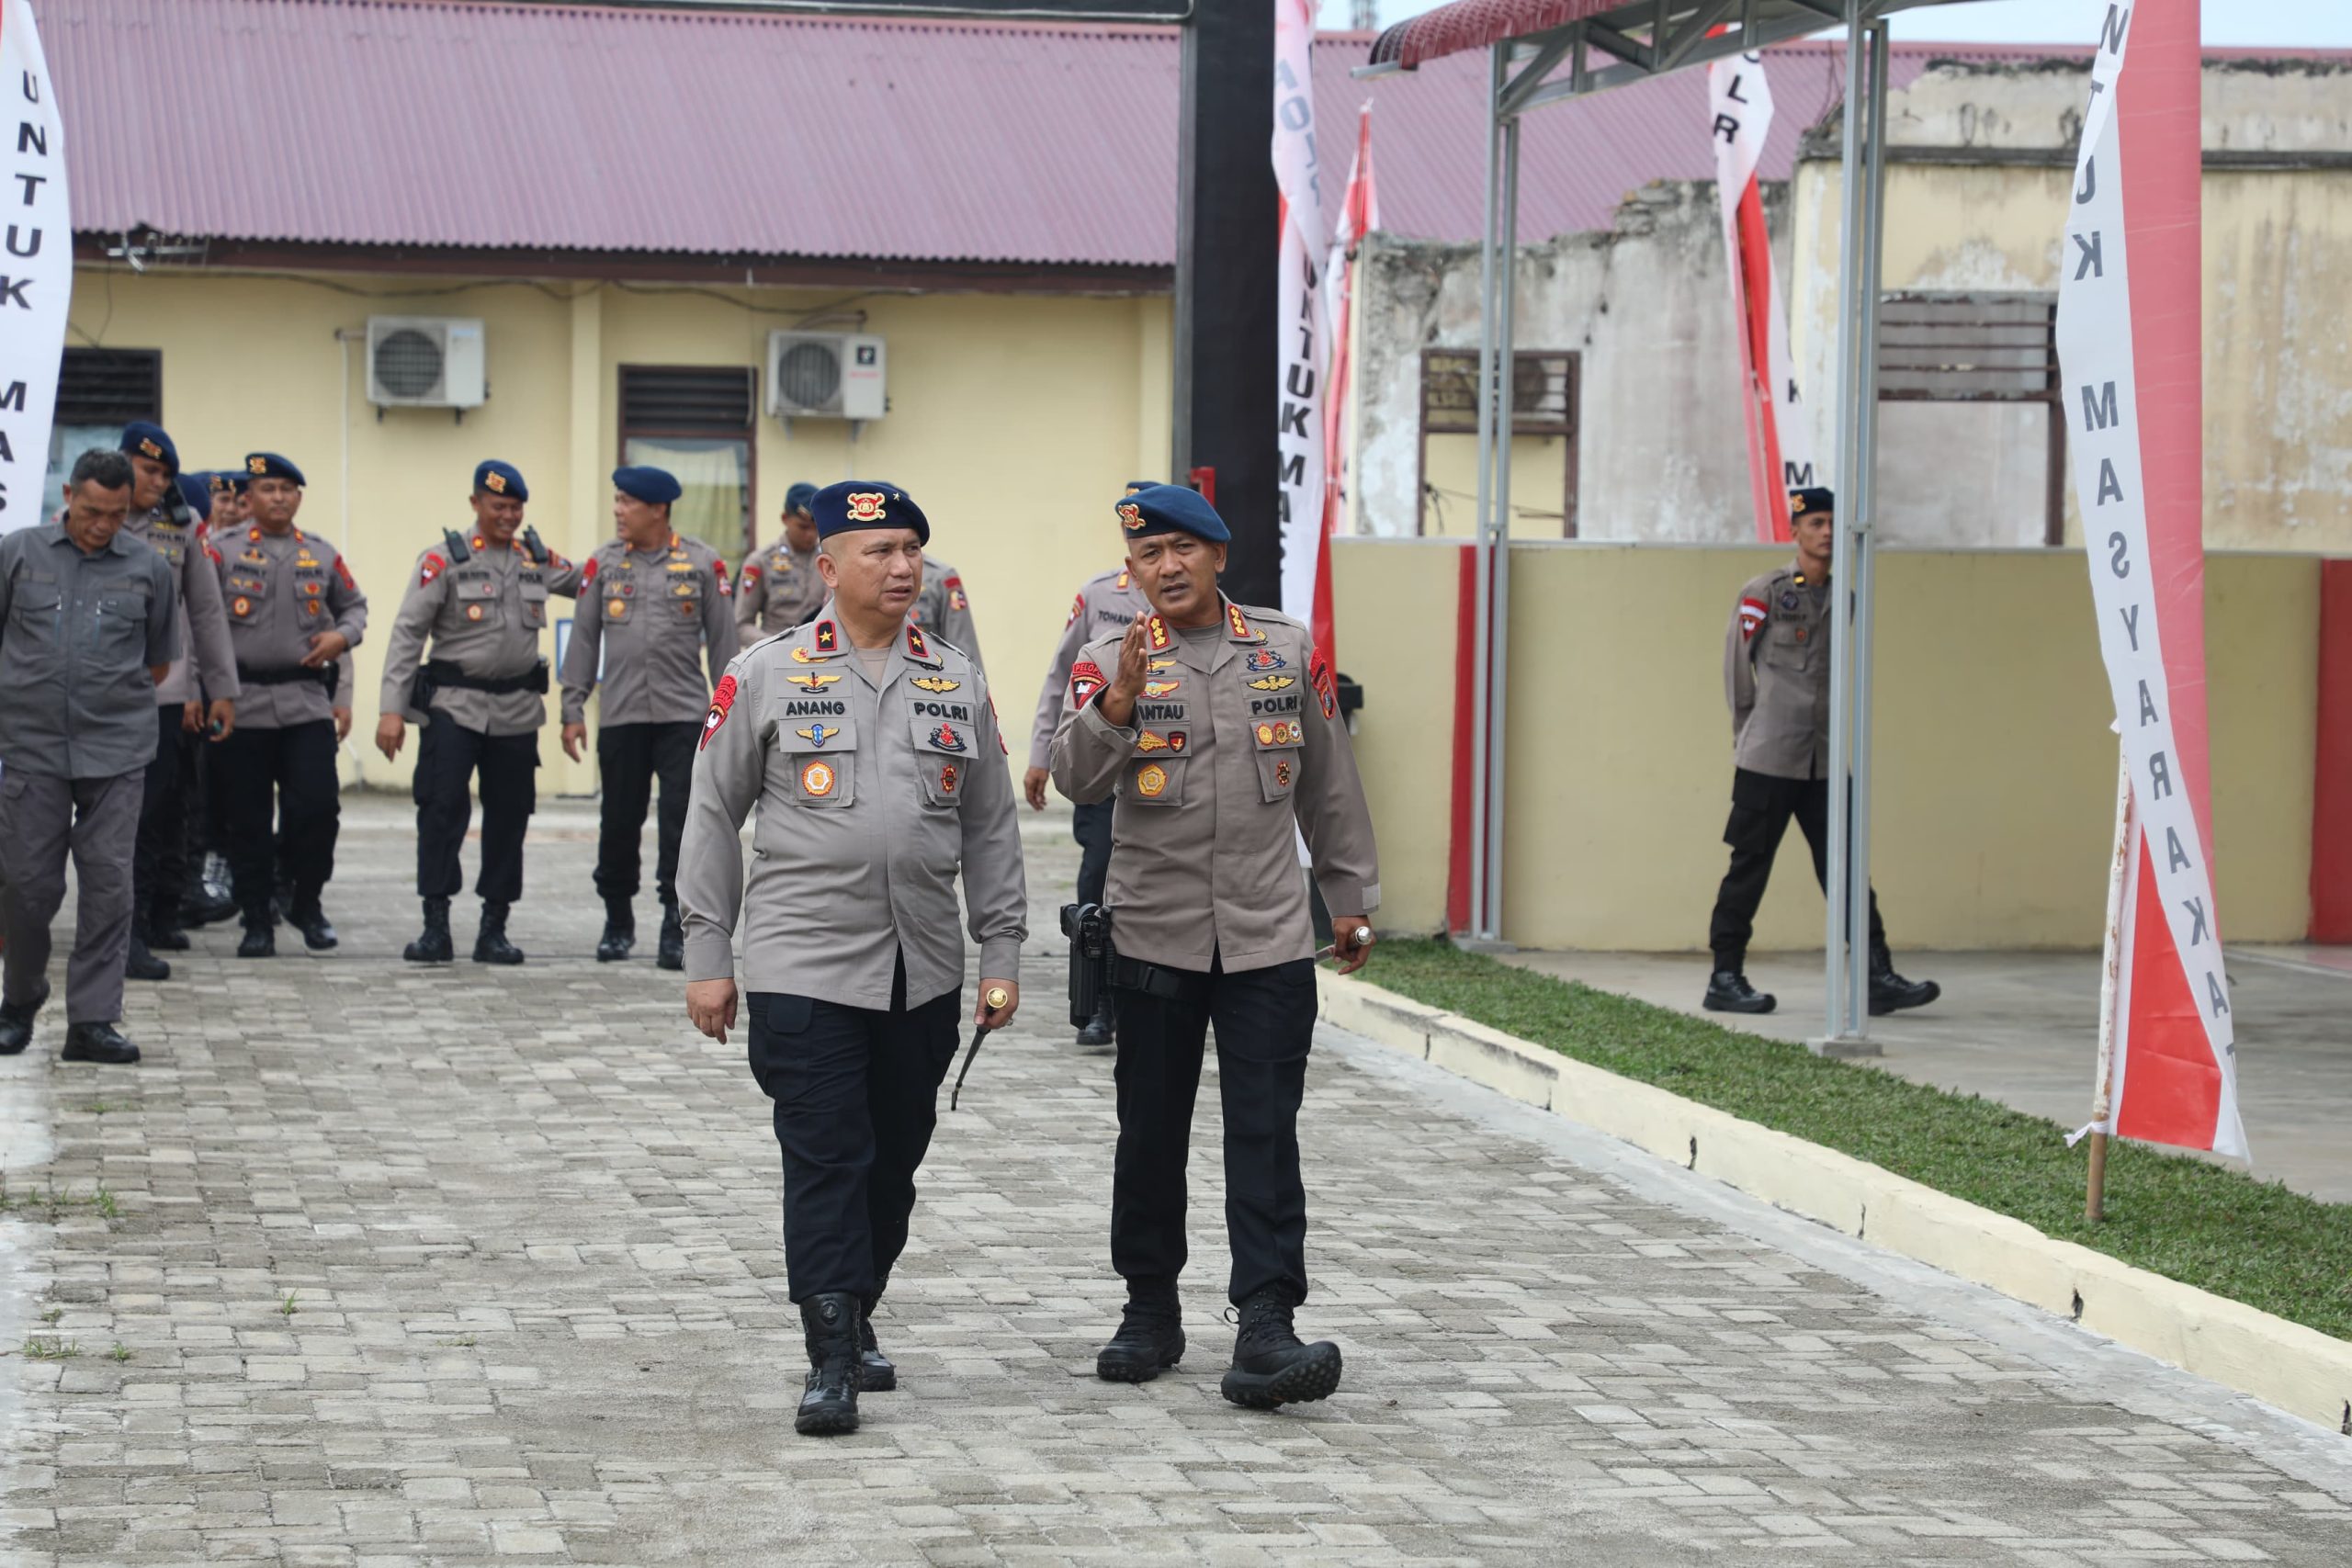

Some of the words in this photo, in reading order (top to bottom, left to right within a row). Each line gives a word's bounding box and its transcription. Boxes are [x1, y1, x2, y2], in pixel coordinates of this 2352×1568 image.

[0, 70, 47, 310] UNTUK
[786, 700, 846, 716] ANANG
[913, 701, 968, 721] POLRI
[1250, 694, 1298, 715] POLRI
